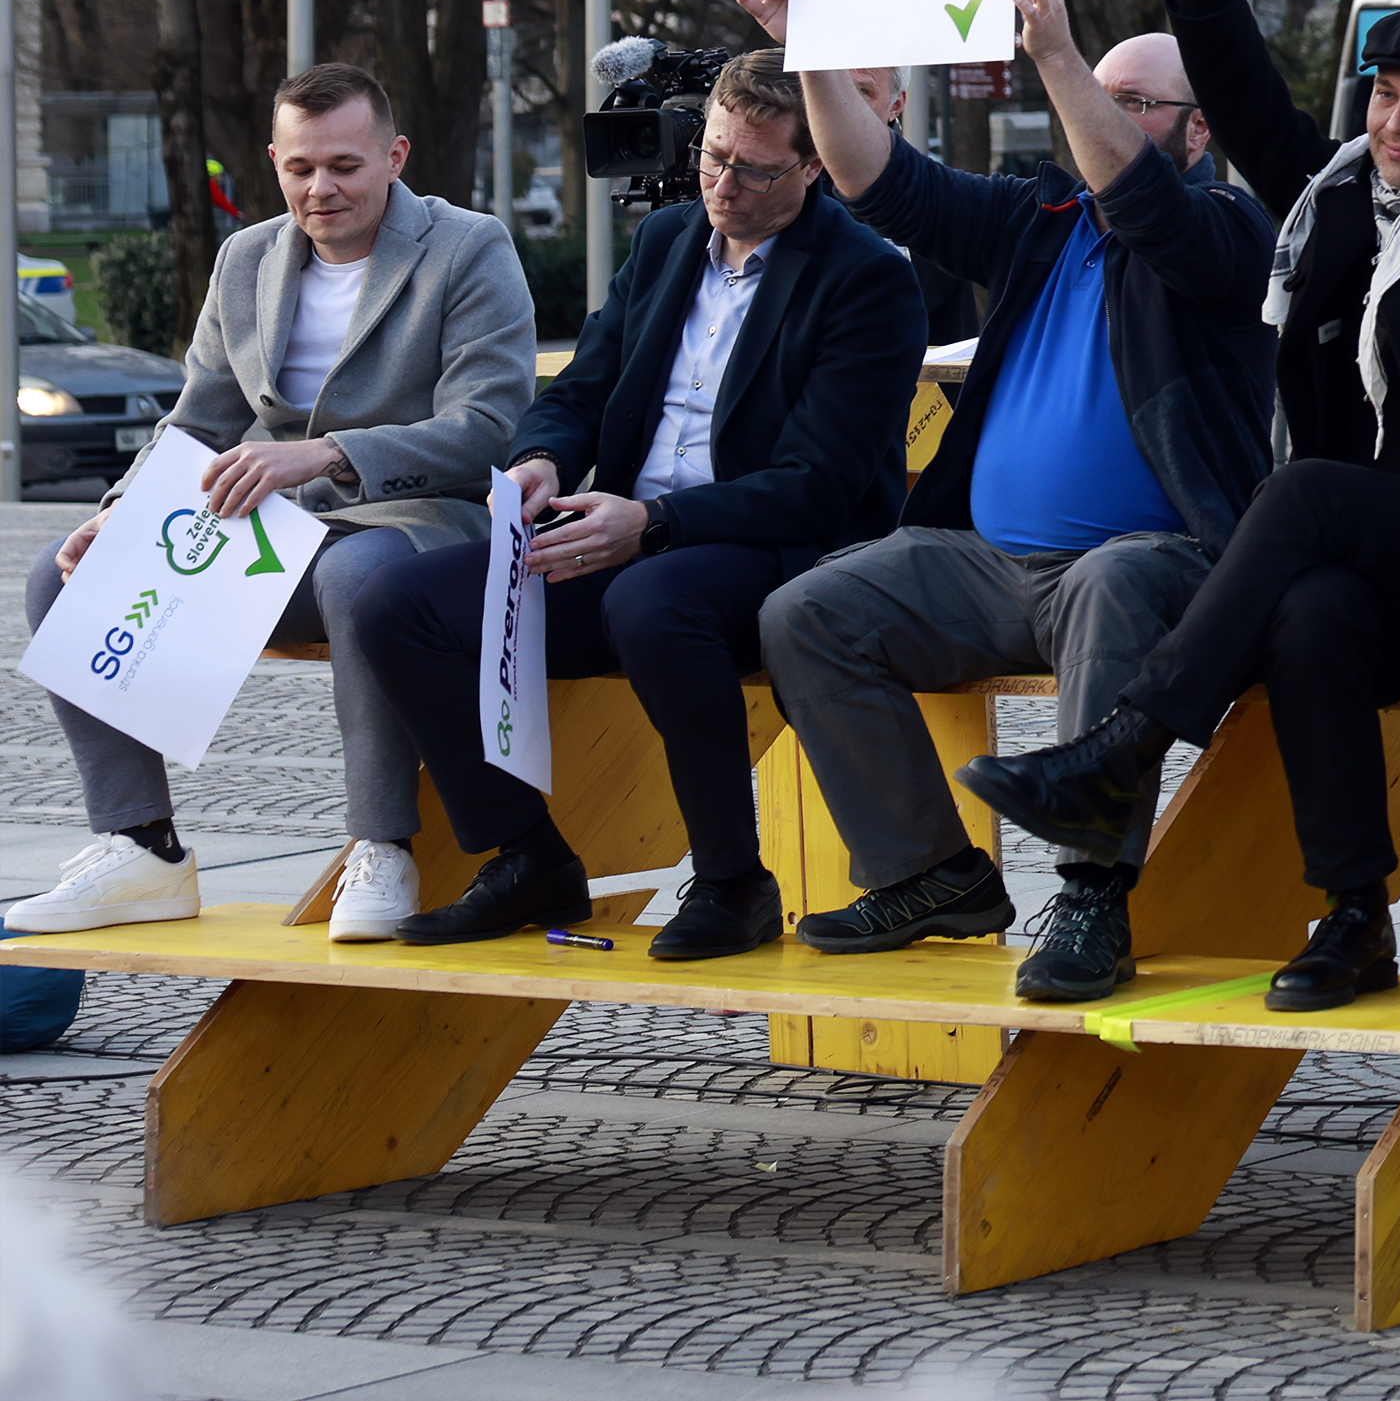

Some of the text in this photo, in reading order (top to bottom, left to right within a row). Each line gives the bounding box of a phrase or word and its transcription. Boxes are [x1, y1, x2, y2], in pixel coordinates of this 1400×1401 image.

[91, 627, 134, 681] SG
[119, 595, 184, 692] stranka generacij
[499, 522, 522, 696] Prerod
